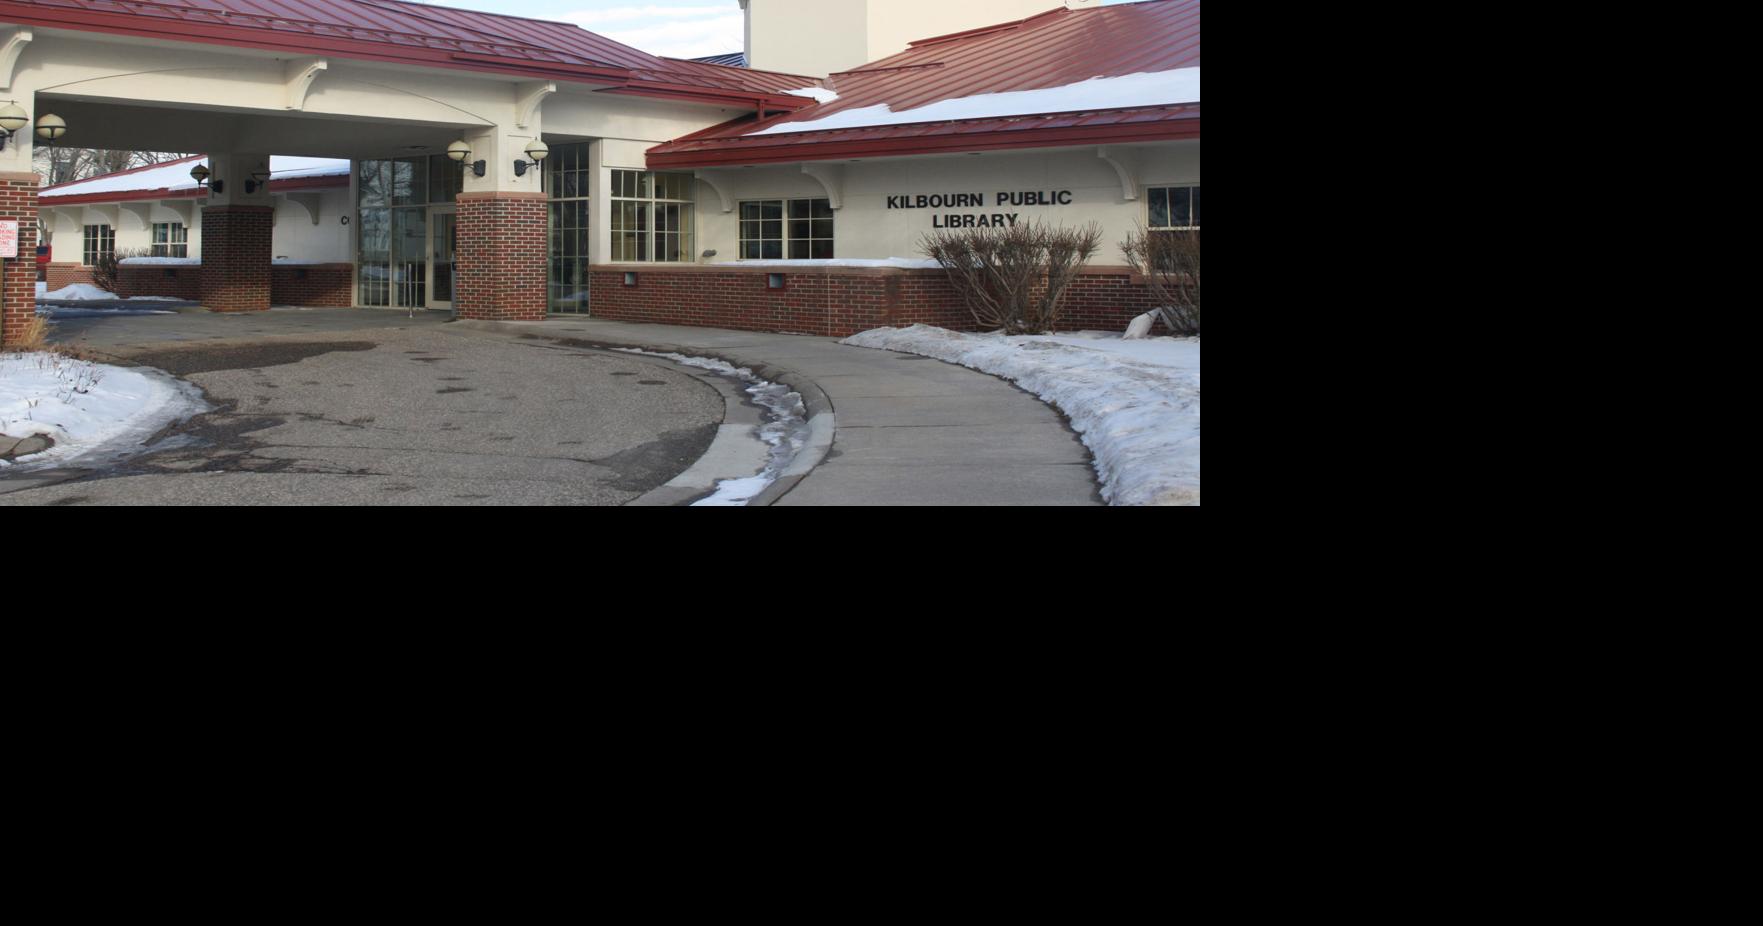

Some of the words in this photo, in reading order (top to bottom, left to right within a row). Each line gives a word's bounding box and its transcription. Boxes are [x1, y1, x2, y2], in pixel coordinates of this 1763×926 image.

[887, 193, 983, 209] KILBOURN
[997, 190, 1072, 206] PUBLIC
[932, 213, 1018, 228] LIBRARY
